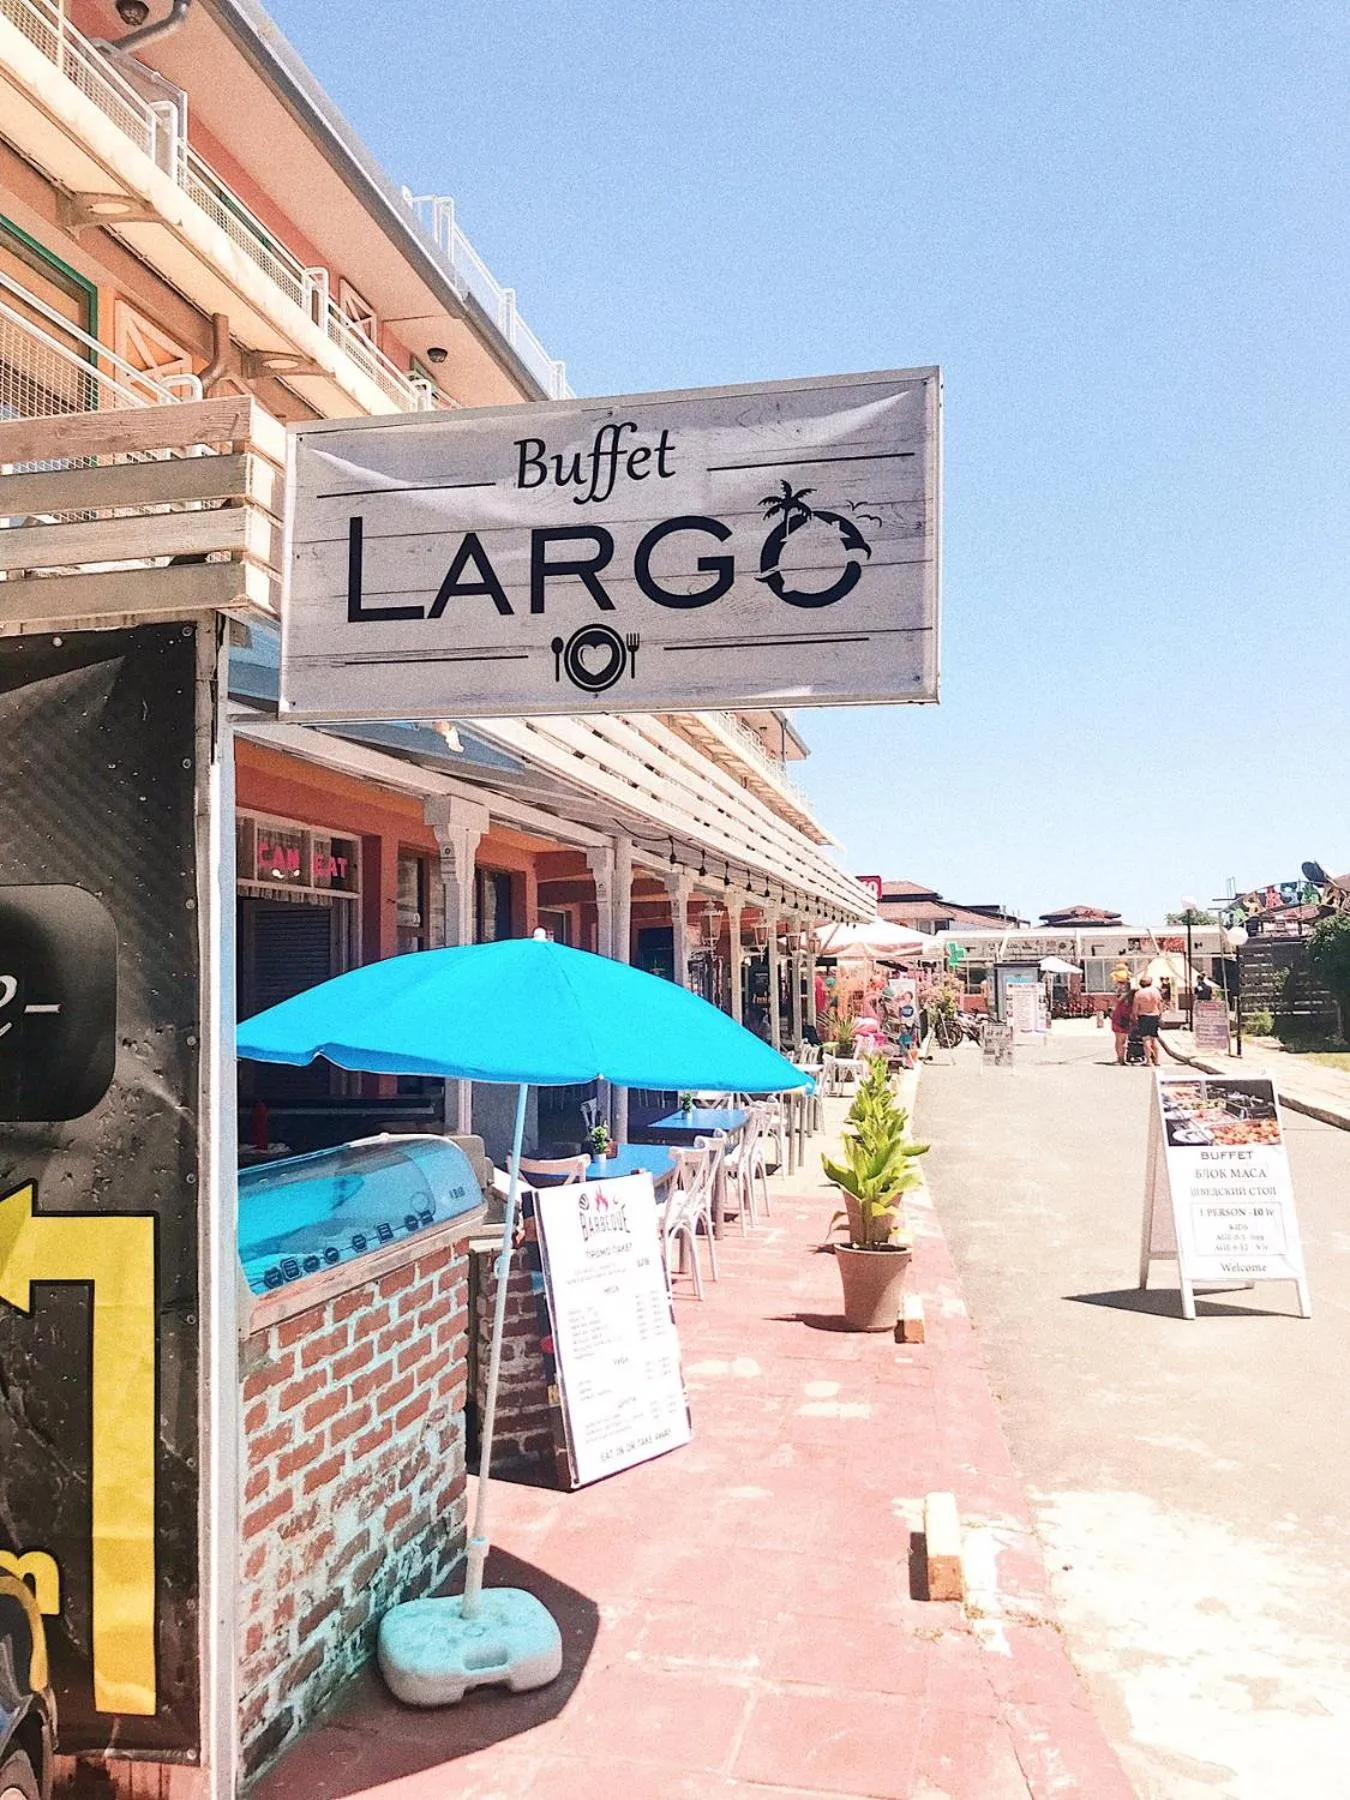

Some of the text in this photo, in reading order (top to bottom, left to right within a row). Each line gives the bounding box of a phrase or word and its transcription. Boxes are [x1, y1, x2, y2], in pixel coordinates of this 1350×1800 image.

[513, 420, 676, 506] Buffet
[346, 508, 873, 624] LARGO
[1200, 1150, 1254, 1160] BUFFET
[1206, 1208, 1246, 1217] PERSON
[1220, 1261, 1267, 1273] Welcome
